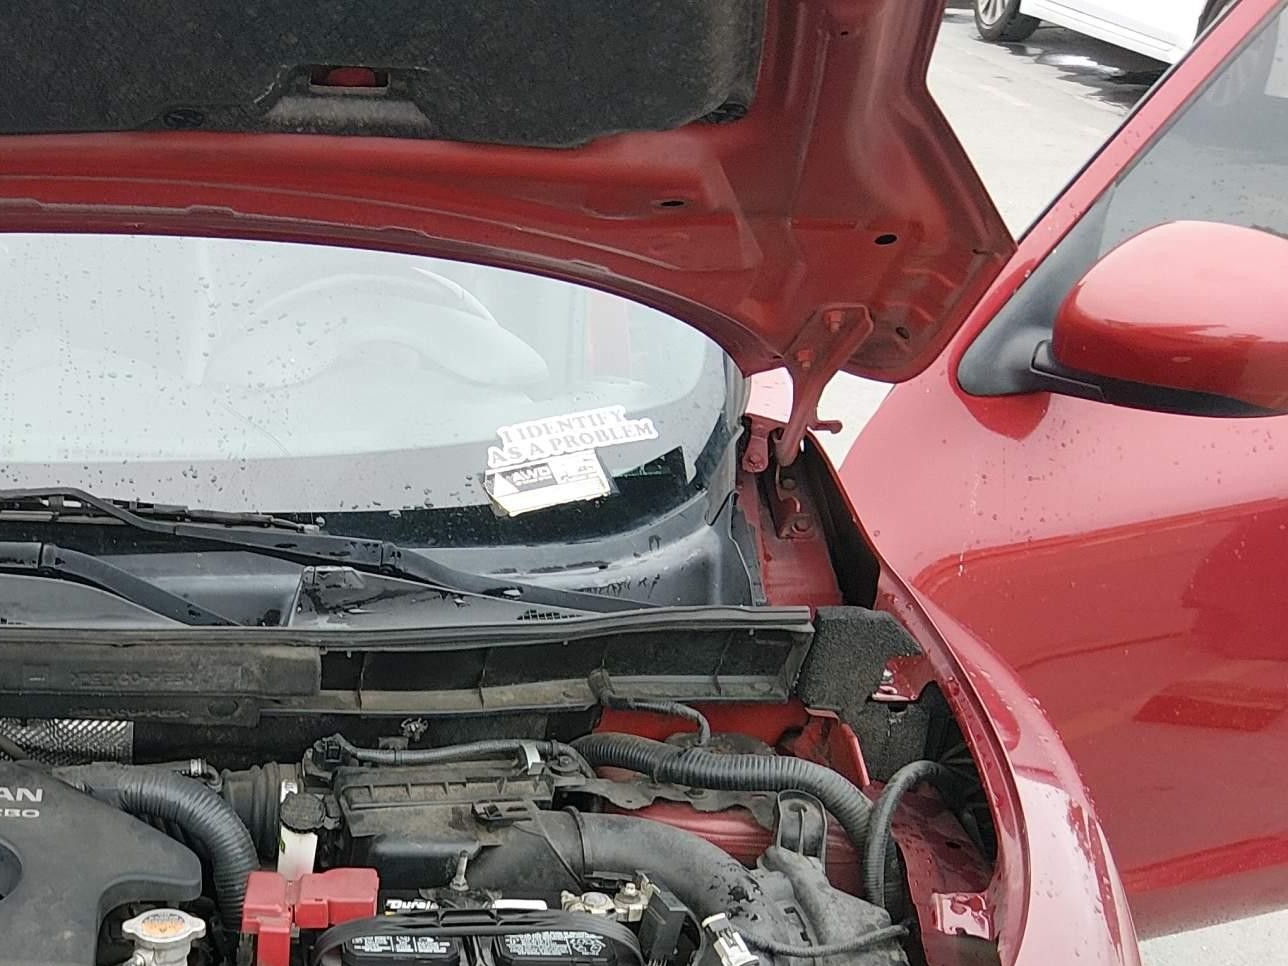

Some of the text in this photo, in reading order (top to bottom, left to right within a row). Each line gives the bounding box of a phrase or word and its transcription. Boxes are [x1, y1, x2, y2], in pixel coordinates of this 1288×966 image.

[516, 408, 622, 440] IDENTIFY
[492, 422, 654, 464] AS A PROBLEM
